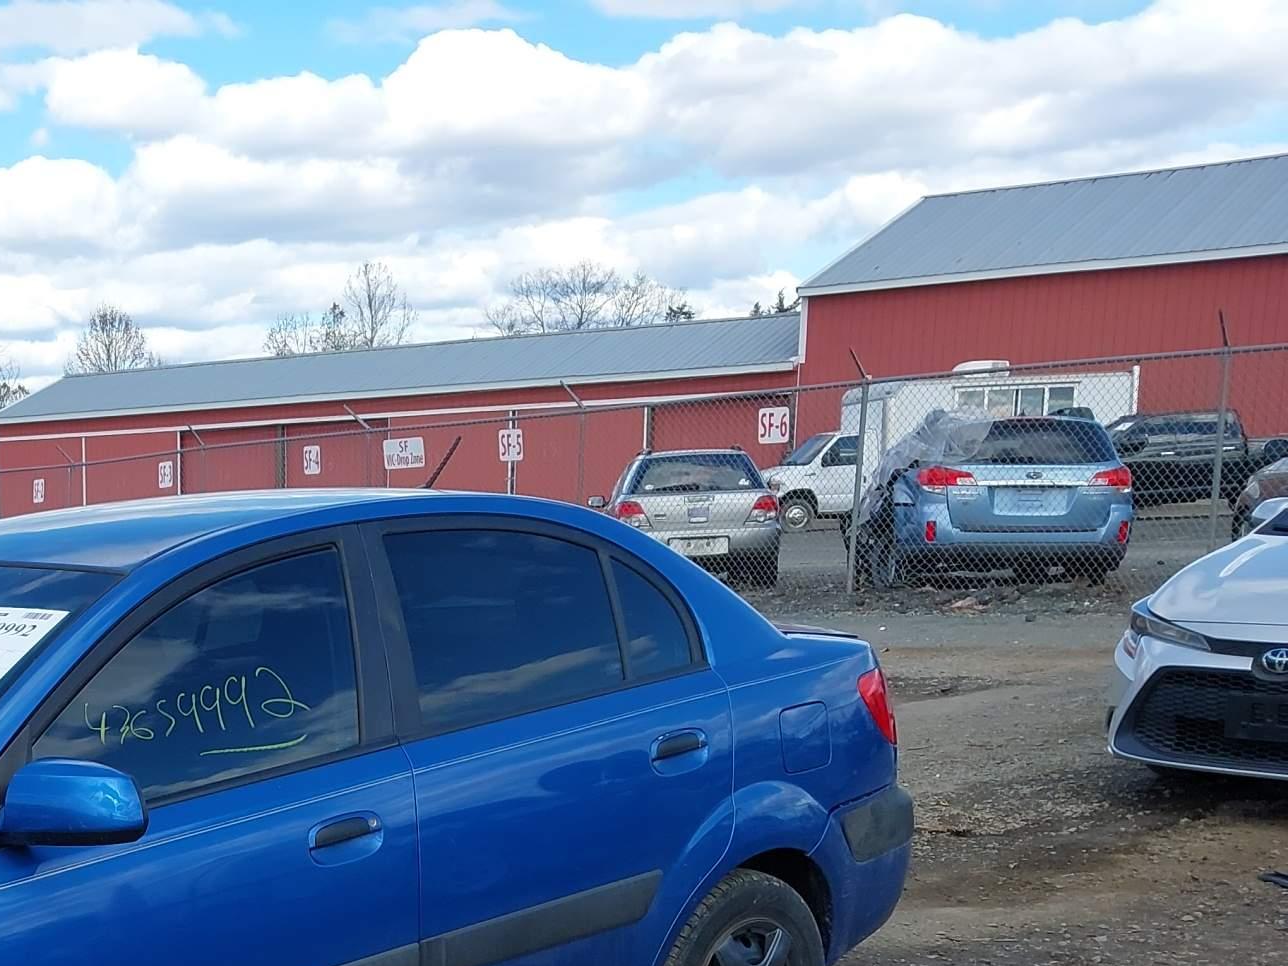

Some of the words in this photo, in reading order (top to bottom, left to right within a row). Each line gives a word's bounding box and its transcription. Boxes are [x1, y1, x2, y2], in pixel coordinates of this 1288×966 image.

[760, 412, 787, 438] SF-6
[398, 440, 409, 453] SF
[501, 433, 522, 456] SF-5
[304, 449, 320, 470] SF-4
[410, 452, 424, 465] Zone
[84, 667, 312, 745] 43659992
